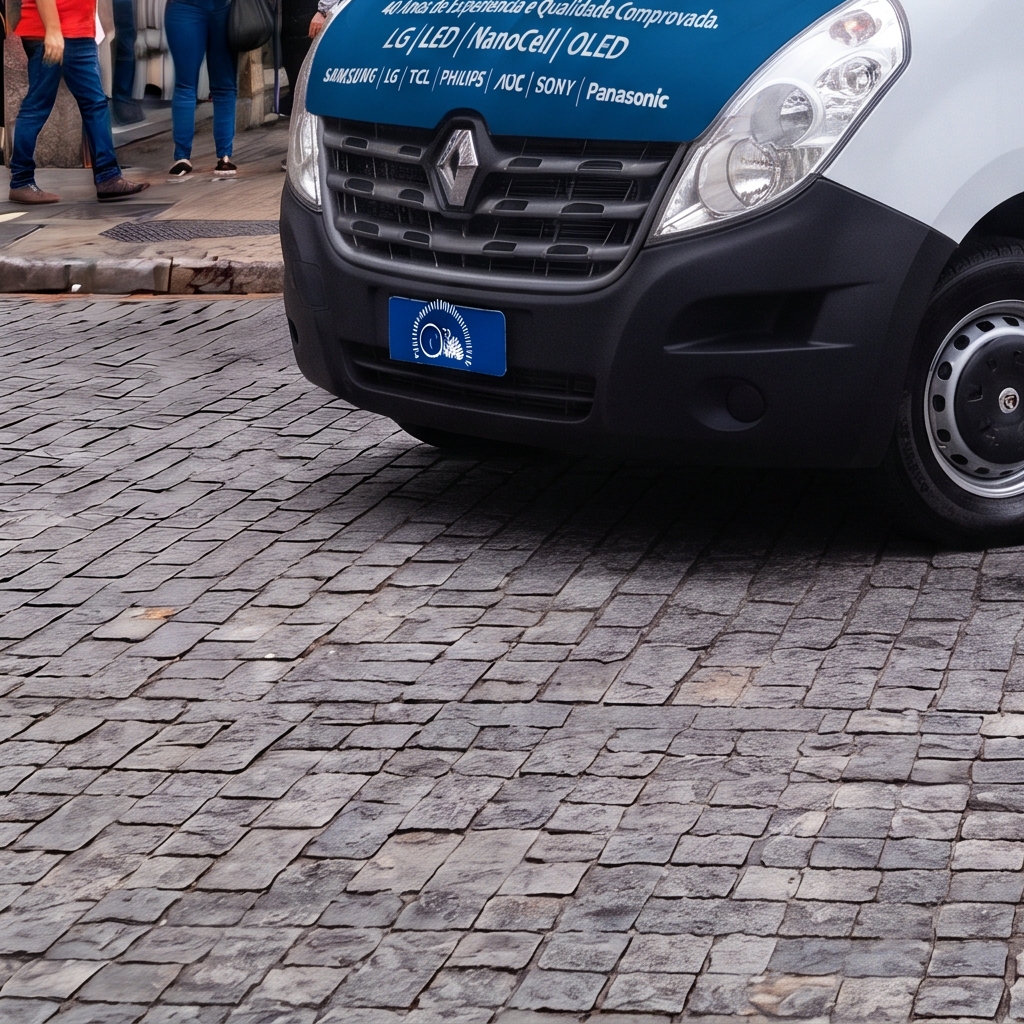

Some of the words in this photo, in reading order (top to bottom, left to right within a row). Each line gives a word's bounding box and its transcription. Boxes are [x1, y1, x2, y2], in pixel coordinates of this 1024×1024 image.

[524, 1, 538, 14] e
[614, 1, 719, 29] Comprovada.
[382, 26, 417, 49] LG
[417, 26, 461, 49] LED
[466, 26, 562, 55] NanoCell
[567, 31, 630, 60] OLED
[322, 67, 379, 85] SAMSUNG
[383, 68, 401, 84] LG
[409, 69, 430, 85] TCL
[439, 69, 487, 88] PHILIPS
[534, 76, 577, 96] SONY
[586, 82, 670, 110] Panasonic
